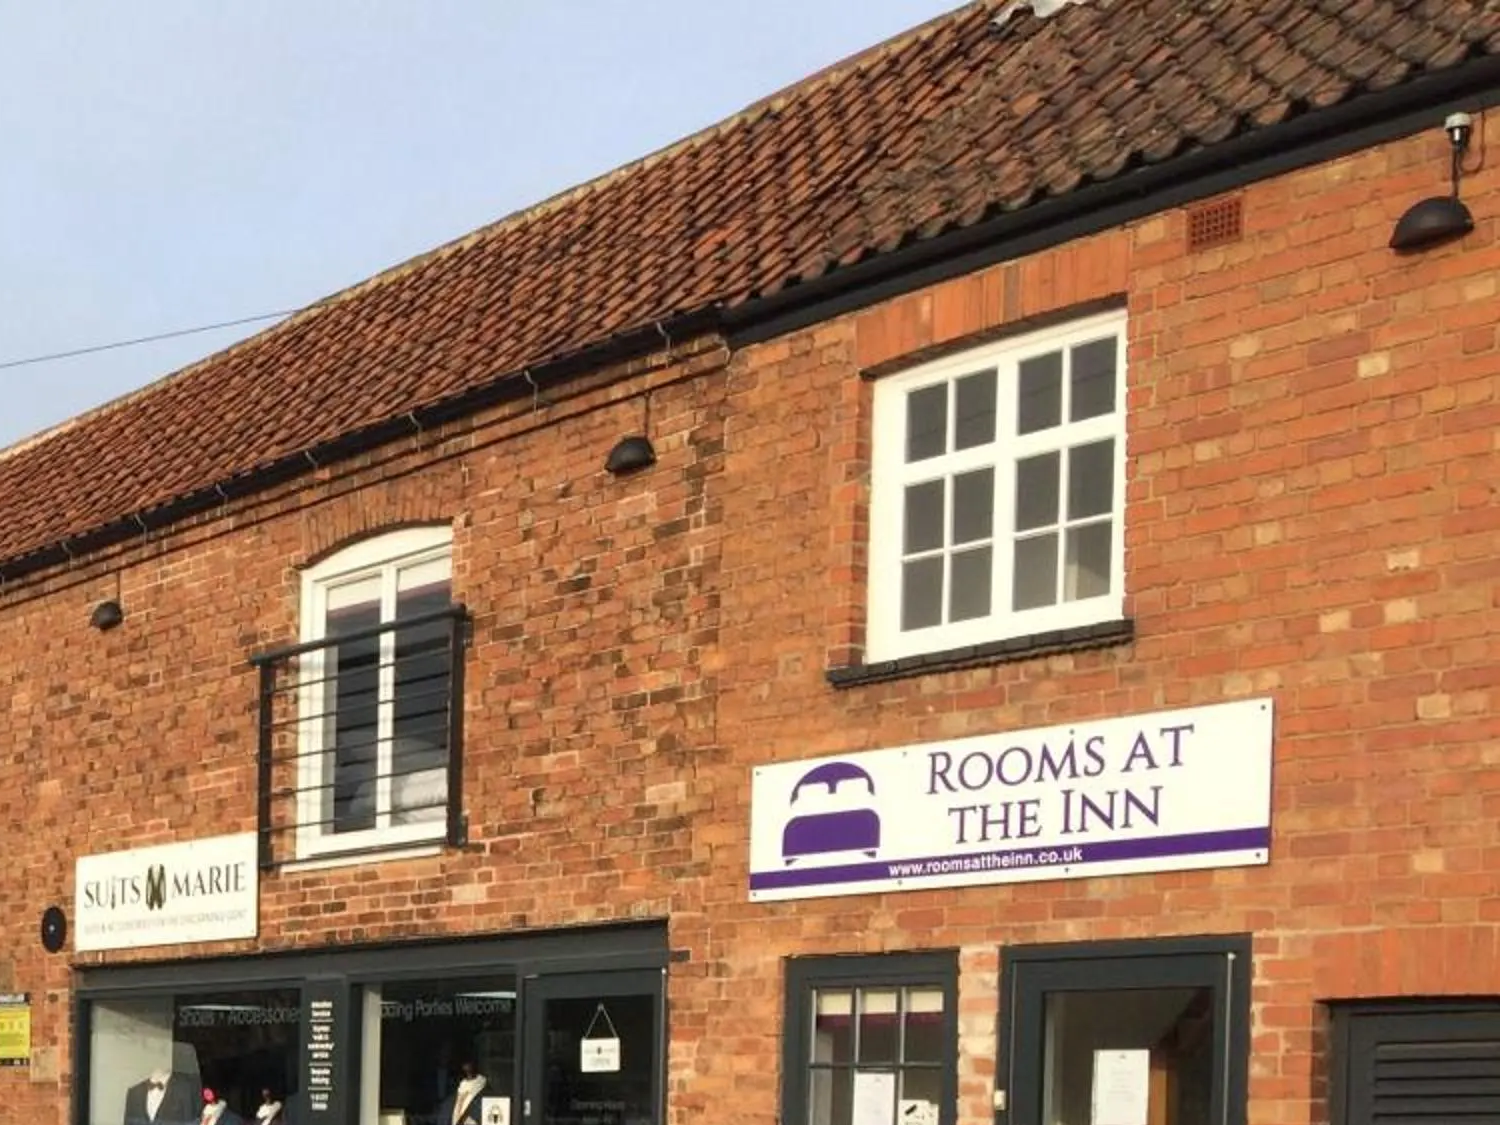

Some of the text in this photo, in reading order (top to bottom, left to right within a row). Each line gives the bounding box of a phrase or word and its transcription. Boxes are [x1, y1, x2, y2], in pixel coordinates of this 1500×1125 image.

[926, 724, 1194, 796] ROOMS AT
[948, 786, 1164, 846] THE INN
[83, 861, 247, 910] SUITS MARIE
[888, 847, 1083, 878] www.roomsattheinn.co.uk
[454, 997, 513, 1016] Welcome
